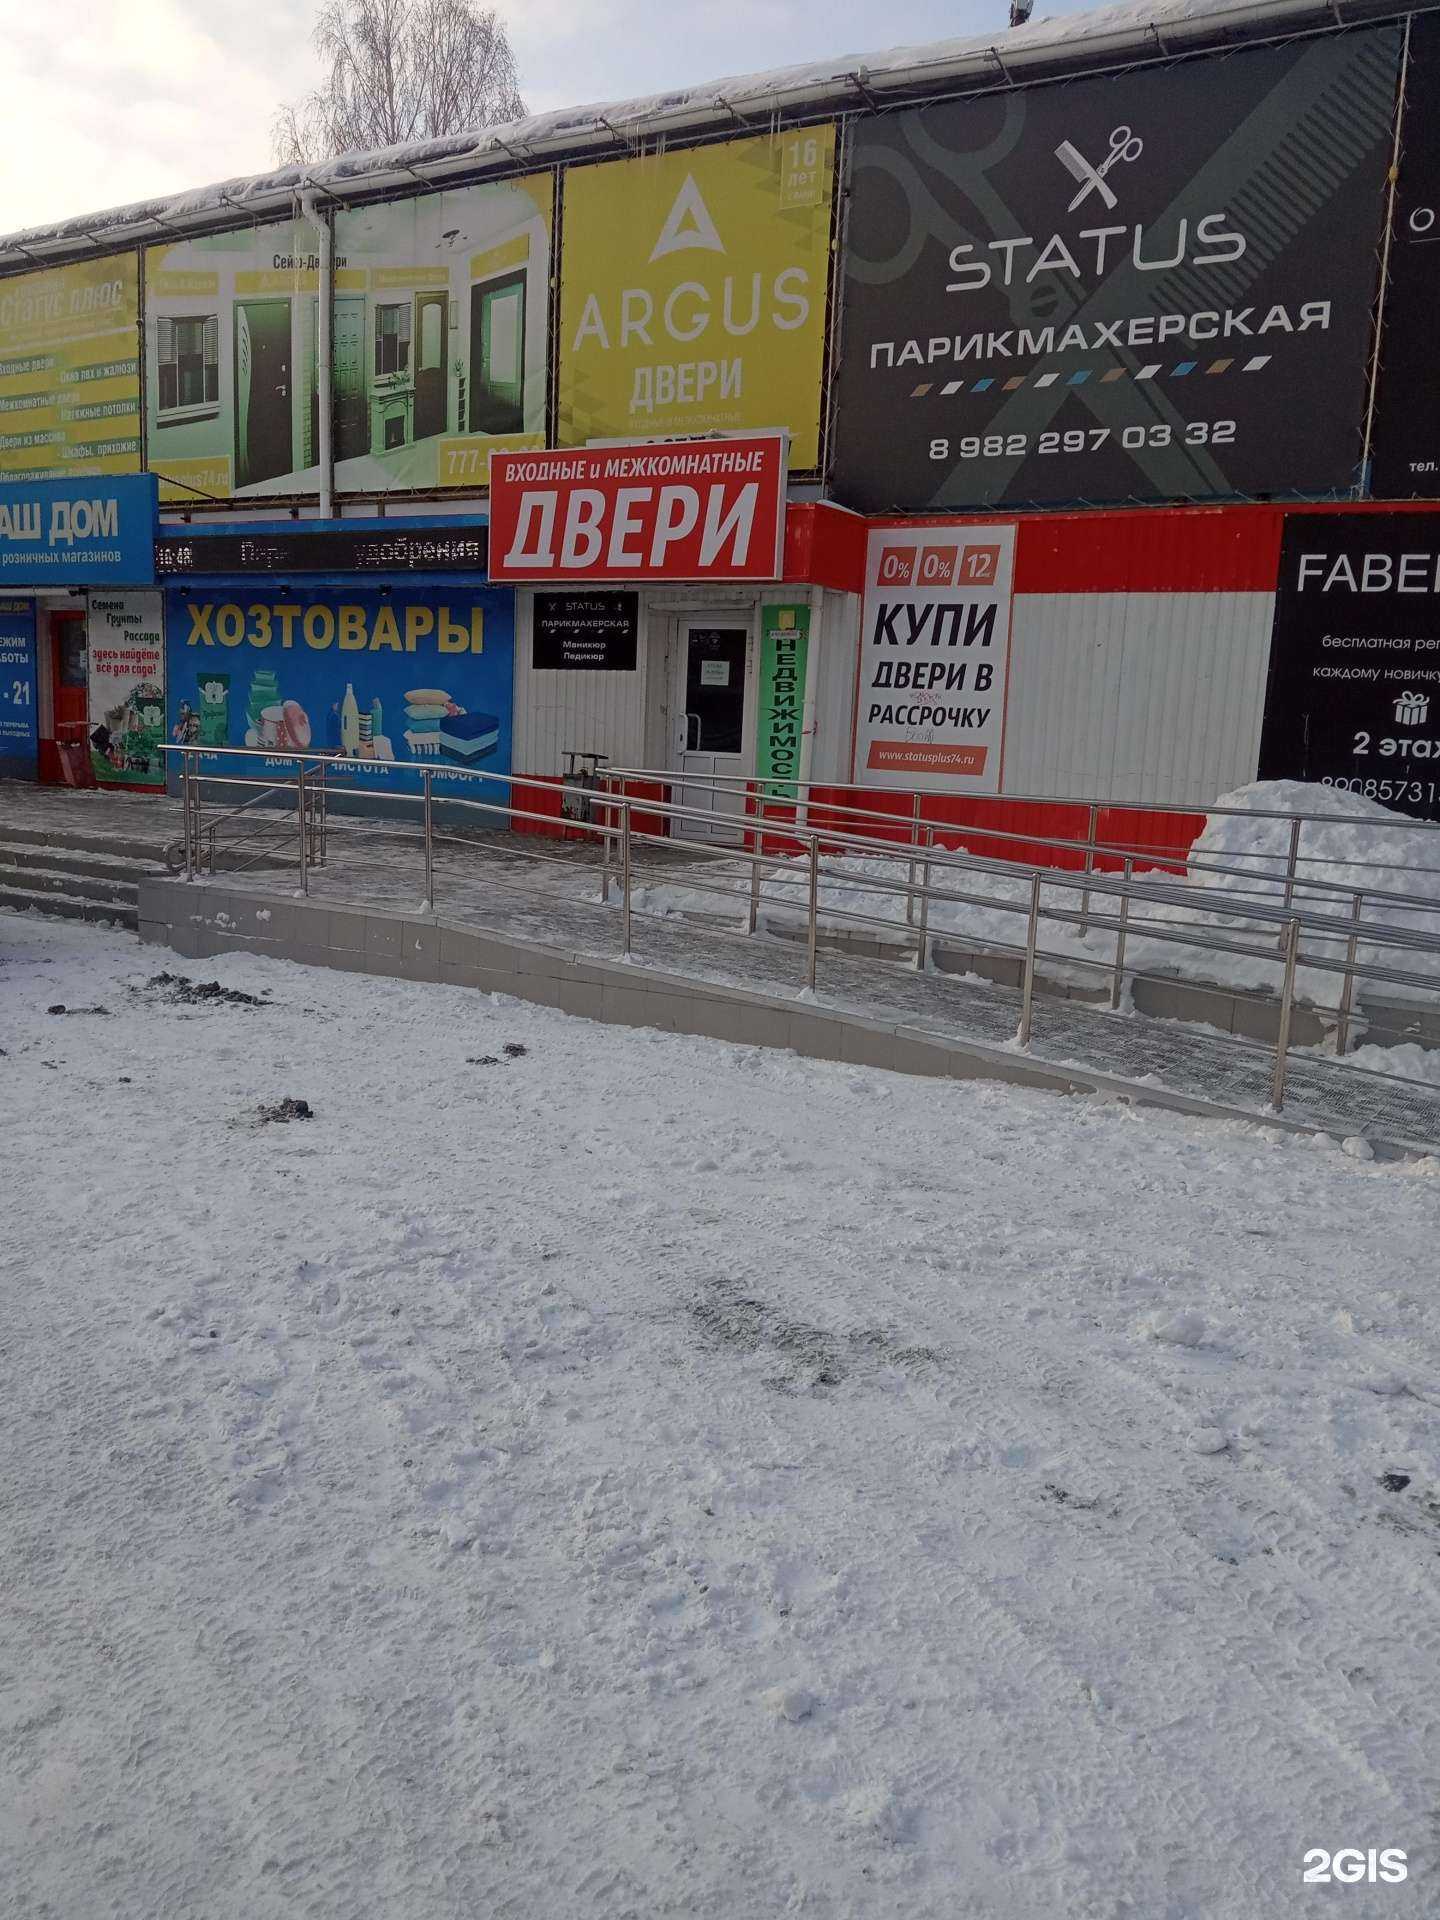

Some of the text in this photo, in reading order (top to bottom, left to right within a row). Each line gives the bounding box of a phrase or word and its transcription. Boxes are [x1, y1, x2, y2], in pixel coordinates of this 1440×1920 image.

[945, 213, 1247, 292] STATUS
[571, 267, 810, 352] ARGUS
[869, 300, 1333, 369] ПАРИКМАХЕРСКАЯ
[629, 357, 743, 414] ДВЕРИ
[928, 419, 1238, 461] 8 982 297 03 32
[505, 450, 765, 483] ВХОДНЫЕ и МЕЖКОМНАТНЫЕ
[1409, 460, 1439, 472] тел.
[48, 498, 119, 547] ДОМ
[502, 482, 760, 569] ДВЕРИ
[2, 550, 122, 567] розничных магазинов
[883, 553, 992, 579] 0% 0% 12
[1297, 553, 1440, 593] FABE
[565, 601, 606, 611] STATUS
[186, 603, 484, 655] ХОЗТОВАРЫ
[541, 619, 630, 628] ПАРИКМАХЕРСКАЯ
[872, 602, 998, 647] КУПИ
[124, 630, 160, 645] Рассада
[562, 640, 606, 650] Маникюр
[1322, 634, 1411, 650] бесплатная
[0, 652, 29, 664] БОТЫ
[563, 651, 605, 661] Педикюр
[872, 661, 994, 692] ДВЕРИ В
[1312, 665, 1381, 682] каждому
[868, 703, 991, 729] РАССРОЧКУ
[1353, 731, 1371, 755] 2
[878, 749, 975, 767] www.statusplus74.ru
